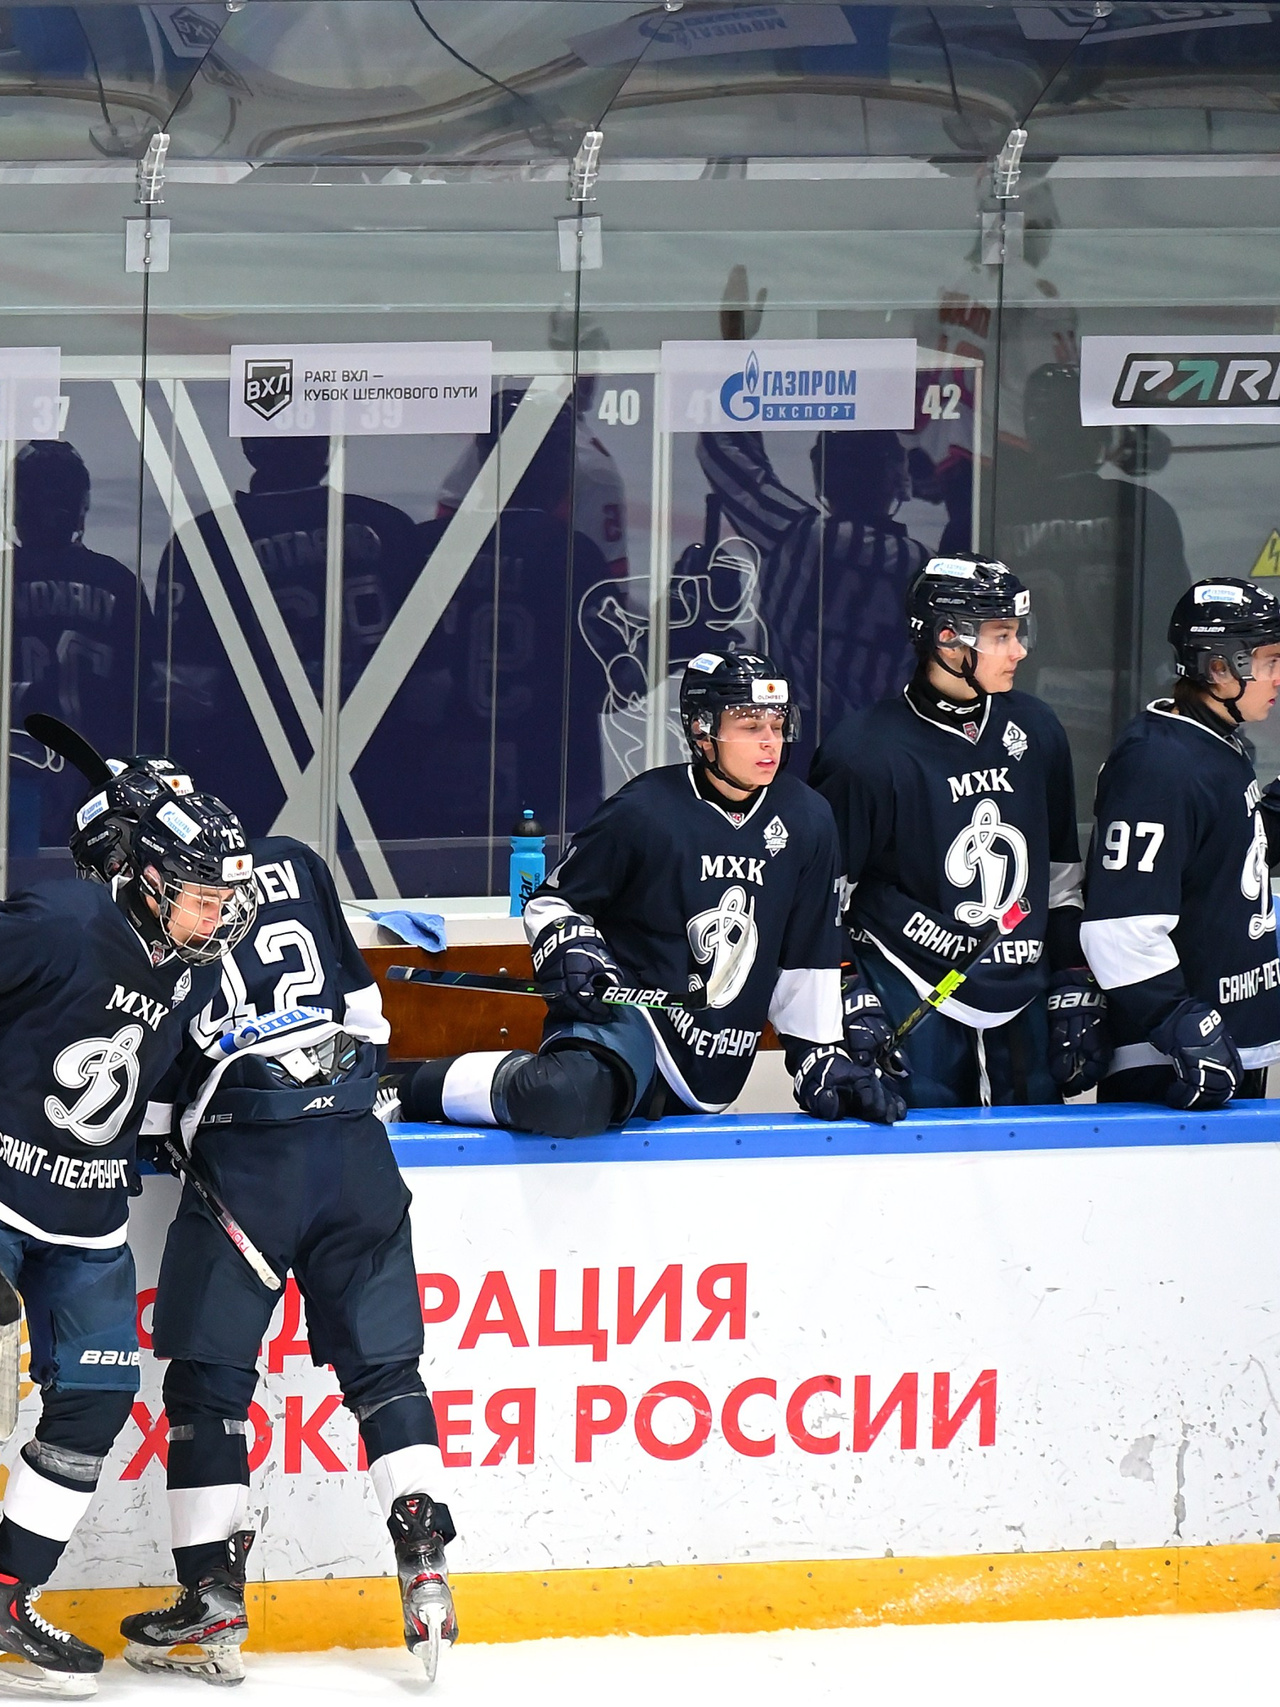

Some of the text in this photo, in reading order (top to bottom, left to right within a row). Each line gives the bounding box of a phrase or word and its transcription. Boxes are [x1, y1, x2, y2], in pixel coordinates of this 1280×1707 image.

[246, 372, 291, 402] ВХЛ
[304, 371, 337, 382] PARI
[342, 370, 368, 382] ВХЛ
[762, 370, 857, 397] ГАЗПРОМ
[304, 386, 478, 401] КУБОК ШЕЛКОВОГО ПУТИ
[598, 389, 641, 426] 40
[921, 384, 962, 421] 42
[765, 404, 853, 420] ЭКСПОРТ
[947, 766, 1015, 803] МХК
[220, 826, 246, 850] 75
[1102, 820, 1165, 873] 97
[699, 853, 767, 886] МХК
[104, 983, 170, 1032] МХК
[575, 1369, 998, 1465] РОССИИ
